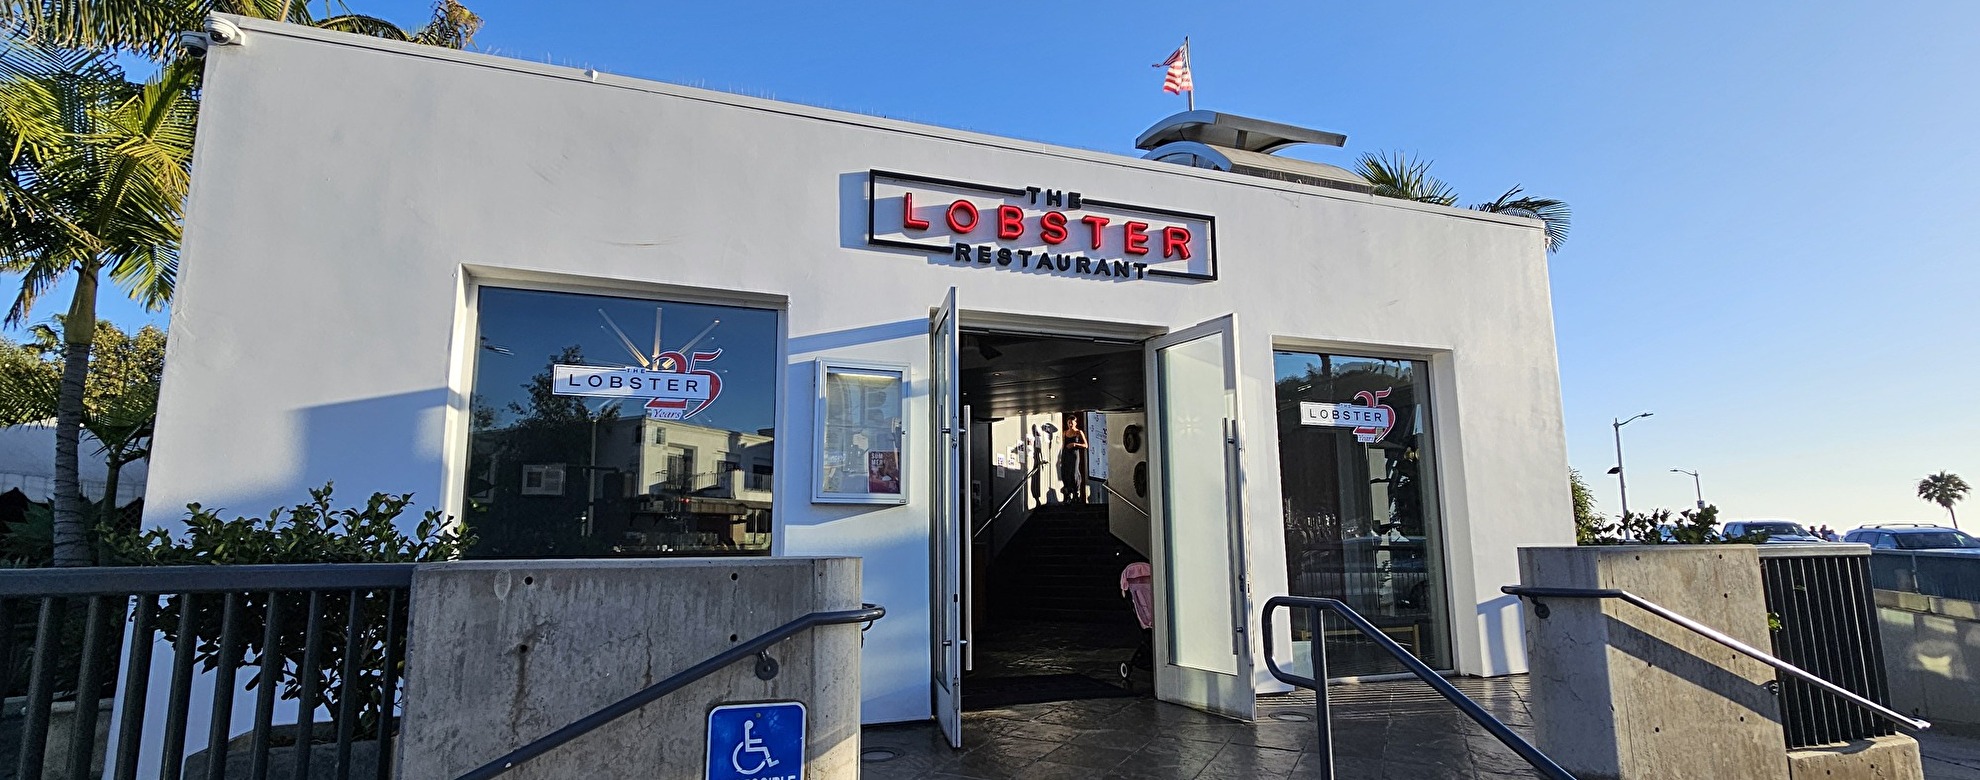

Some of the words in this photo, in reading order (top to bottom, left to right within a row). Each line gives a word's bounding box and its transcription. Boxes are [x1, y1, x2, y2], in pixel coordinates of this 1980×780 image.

[1026, 186, 1082, 210] THE
[903, 192, 1192, 260] LOBSTER
[955, 243, 1148, 280] RESTAURANT
[569, 374, 698, 392] LOBSTER
[644, 348, 723, 419] 25
[653, 409, 682, 419] Years
[1309, 409, 1382, 422] LOBSTER
[1353, 386, 1396, 443] 25
